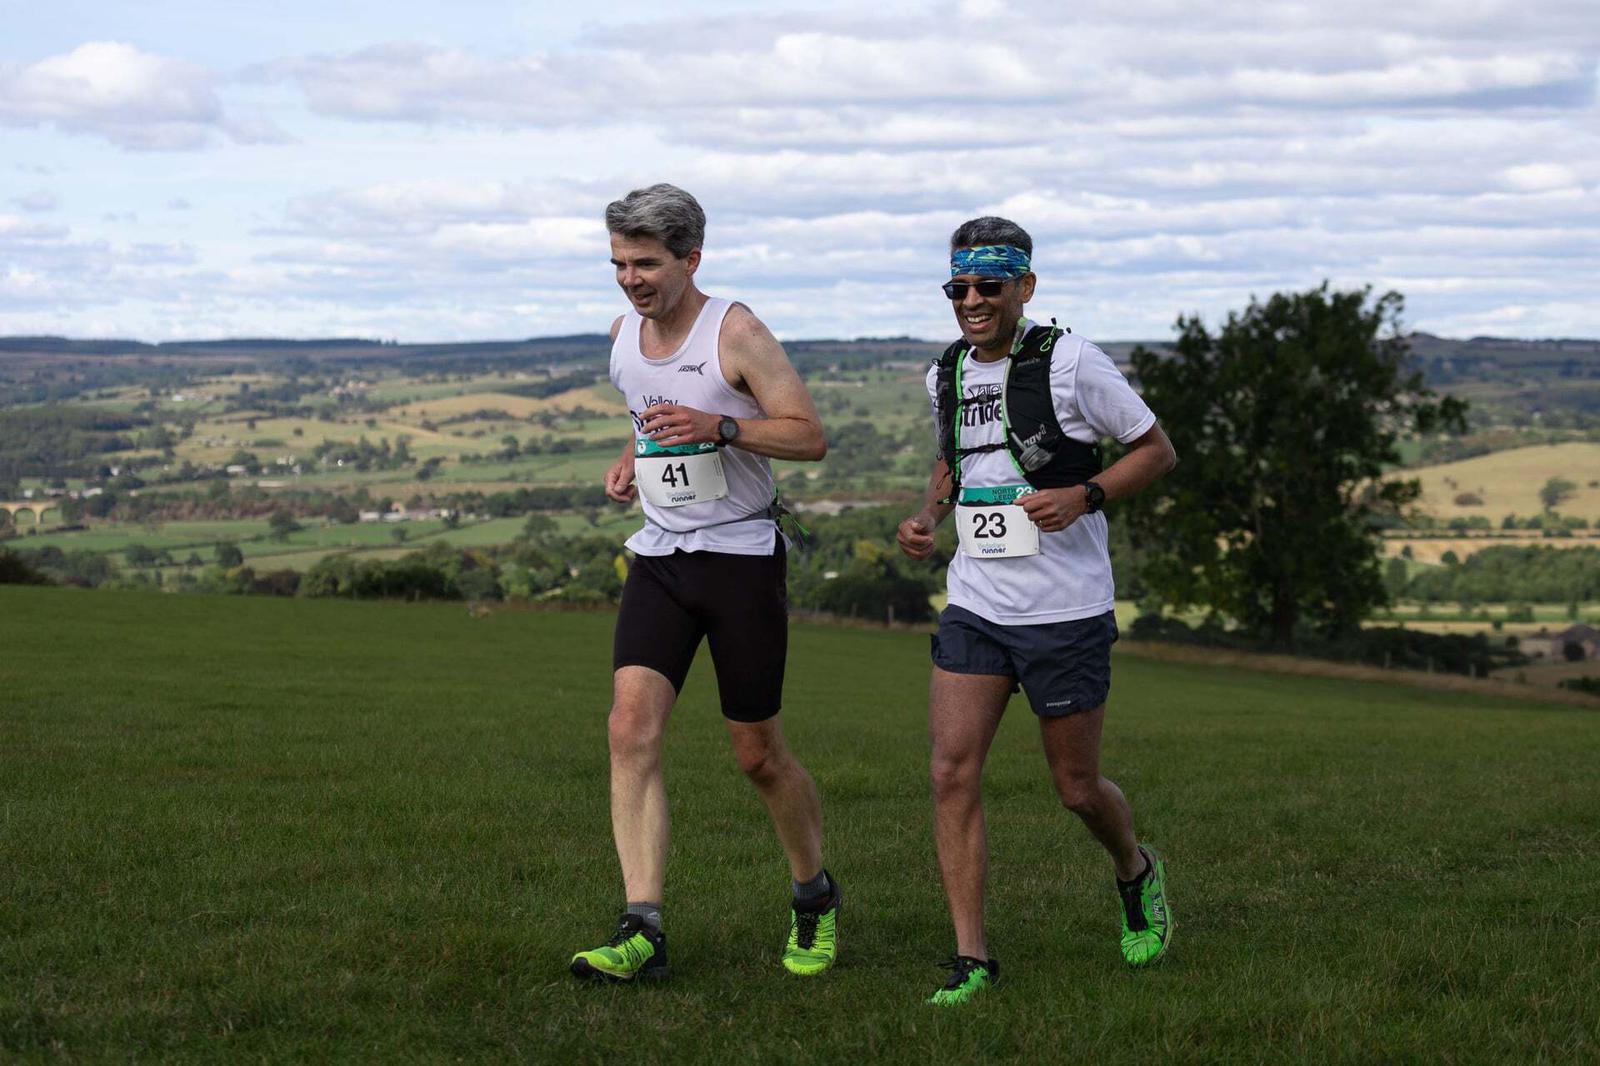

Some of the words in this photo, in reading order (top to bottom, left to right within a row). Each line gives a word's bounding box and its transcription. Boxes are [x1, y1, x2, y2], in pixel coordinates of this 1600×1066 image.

[661, 462, 690, 488] 41
[671, 494, 696, 503] runner
[972, 512, 1007, 538] 23
